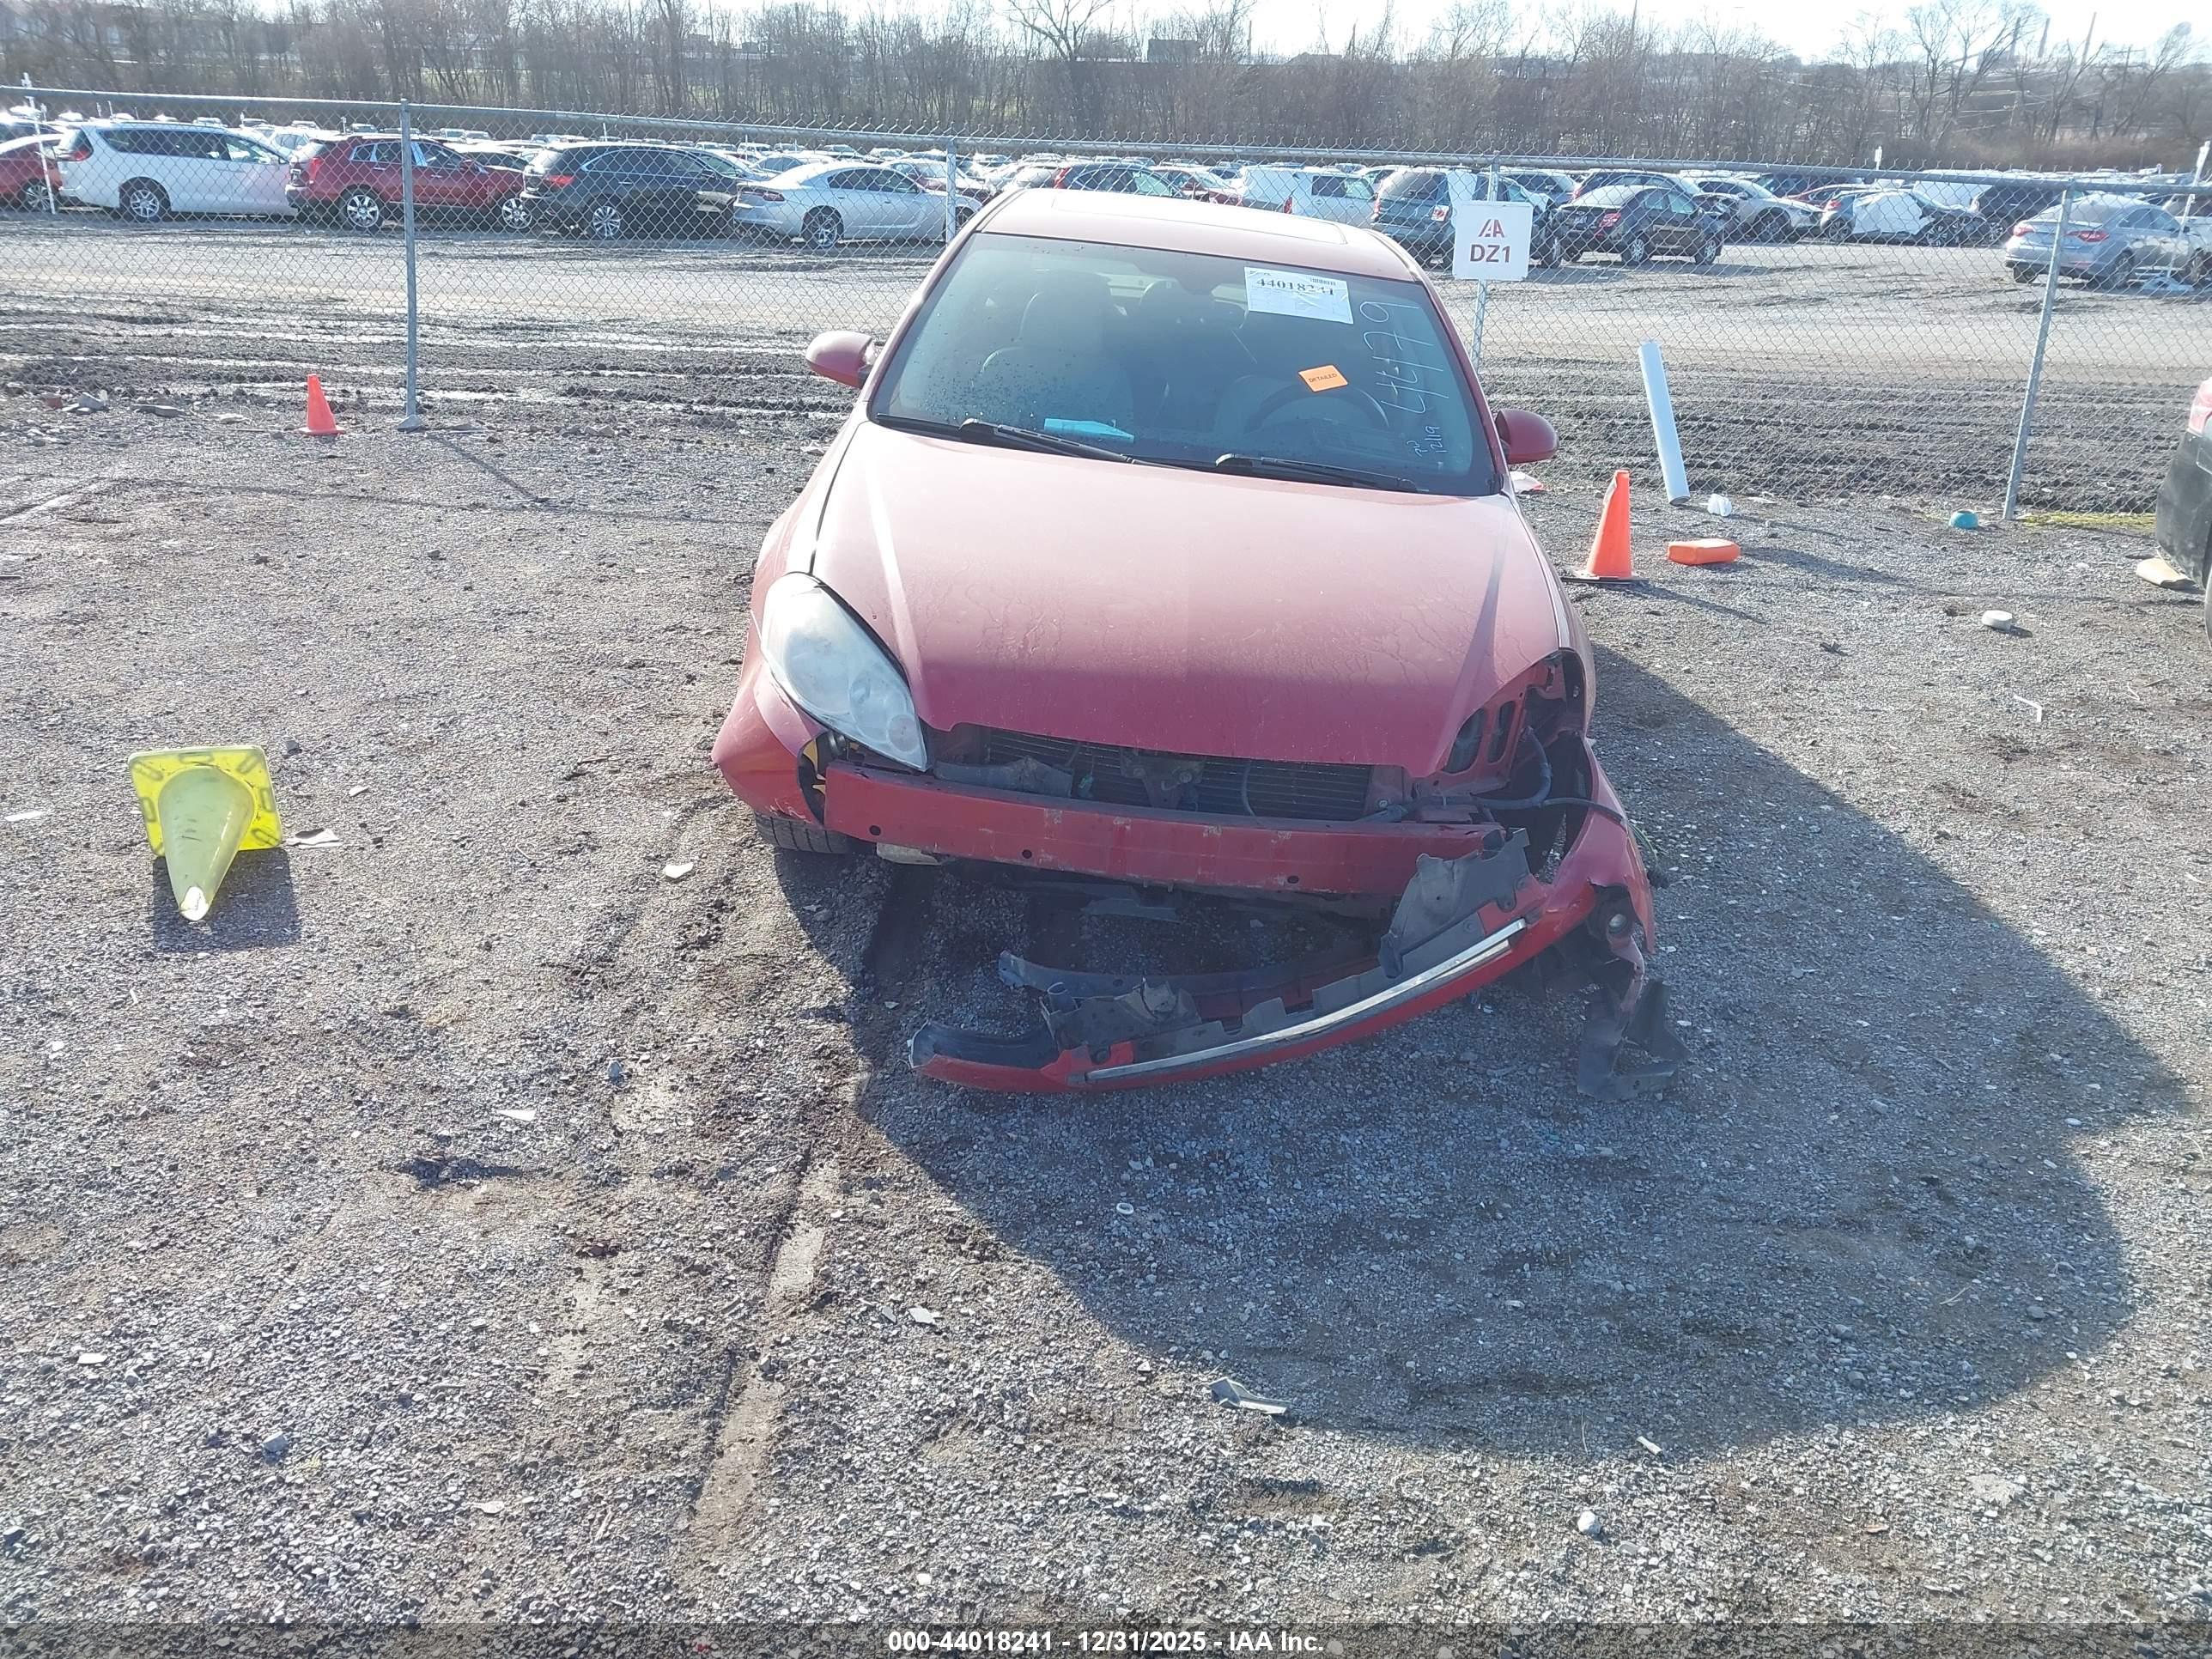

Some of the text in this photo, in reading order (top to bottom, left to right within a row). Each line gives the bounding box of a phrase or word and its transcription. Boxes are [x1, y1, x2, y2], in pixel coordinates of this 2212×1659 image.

[1469, 244, 1511, 263] DZ1
[1359, 301, 1449, 414] 4479
[1308, 373, 1338, 383] DETAILED
